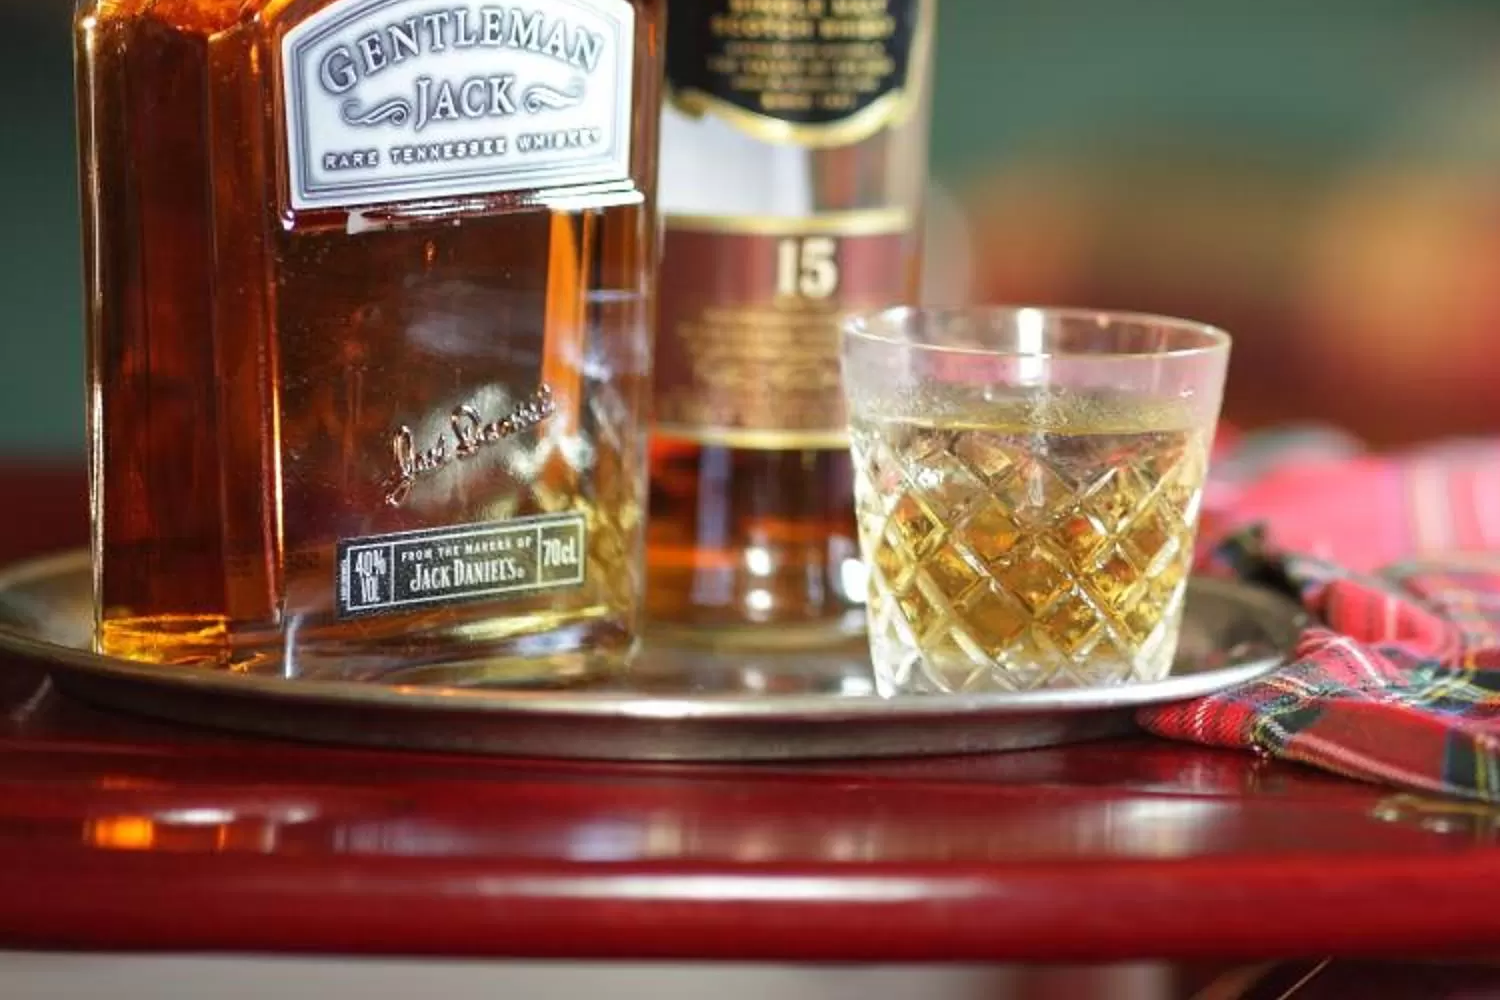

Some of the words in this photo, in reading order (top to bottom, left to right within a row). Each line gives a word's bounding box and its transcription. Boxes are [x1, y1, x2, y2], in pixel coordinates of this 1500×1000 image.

[319, 5, 603, 95] GENTLEMAN
[414, 73, 517, 131] JACK
[324, 147, 378, 172] RARE
[390, 137, 507, 165] TENNESSEE
[778, 237, 838, 298] 15
[355, 549, 387, 577] 40%
[401, 548, 432, 562] FROM
[438, 545, 460, 558] THE
[464, 537, 512, 554] MAKERS
[517, 535, 532, 548] OF
[410, 563, 451, 592] JACK
